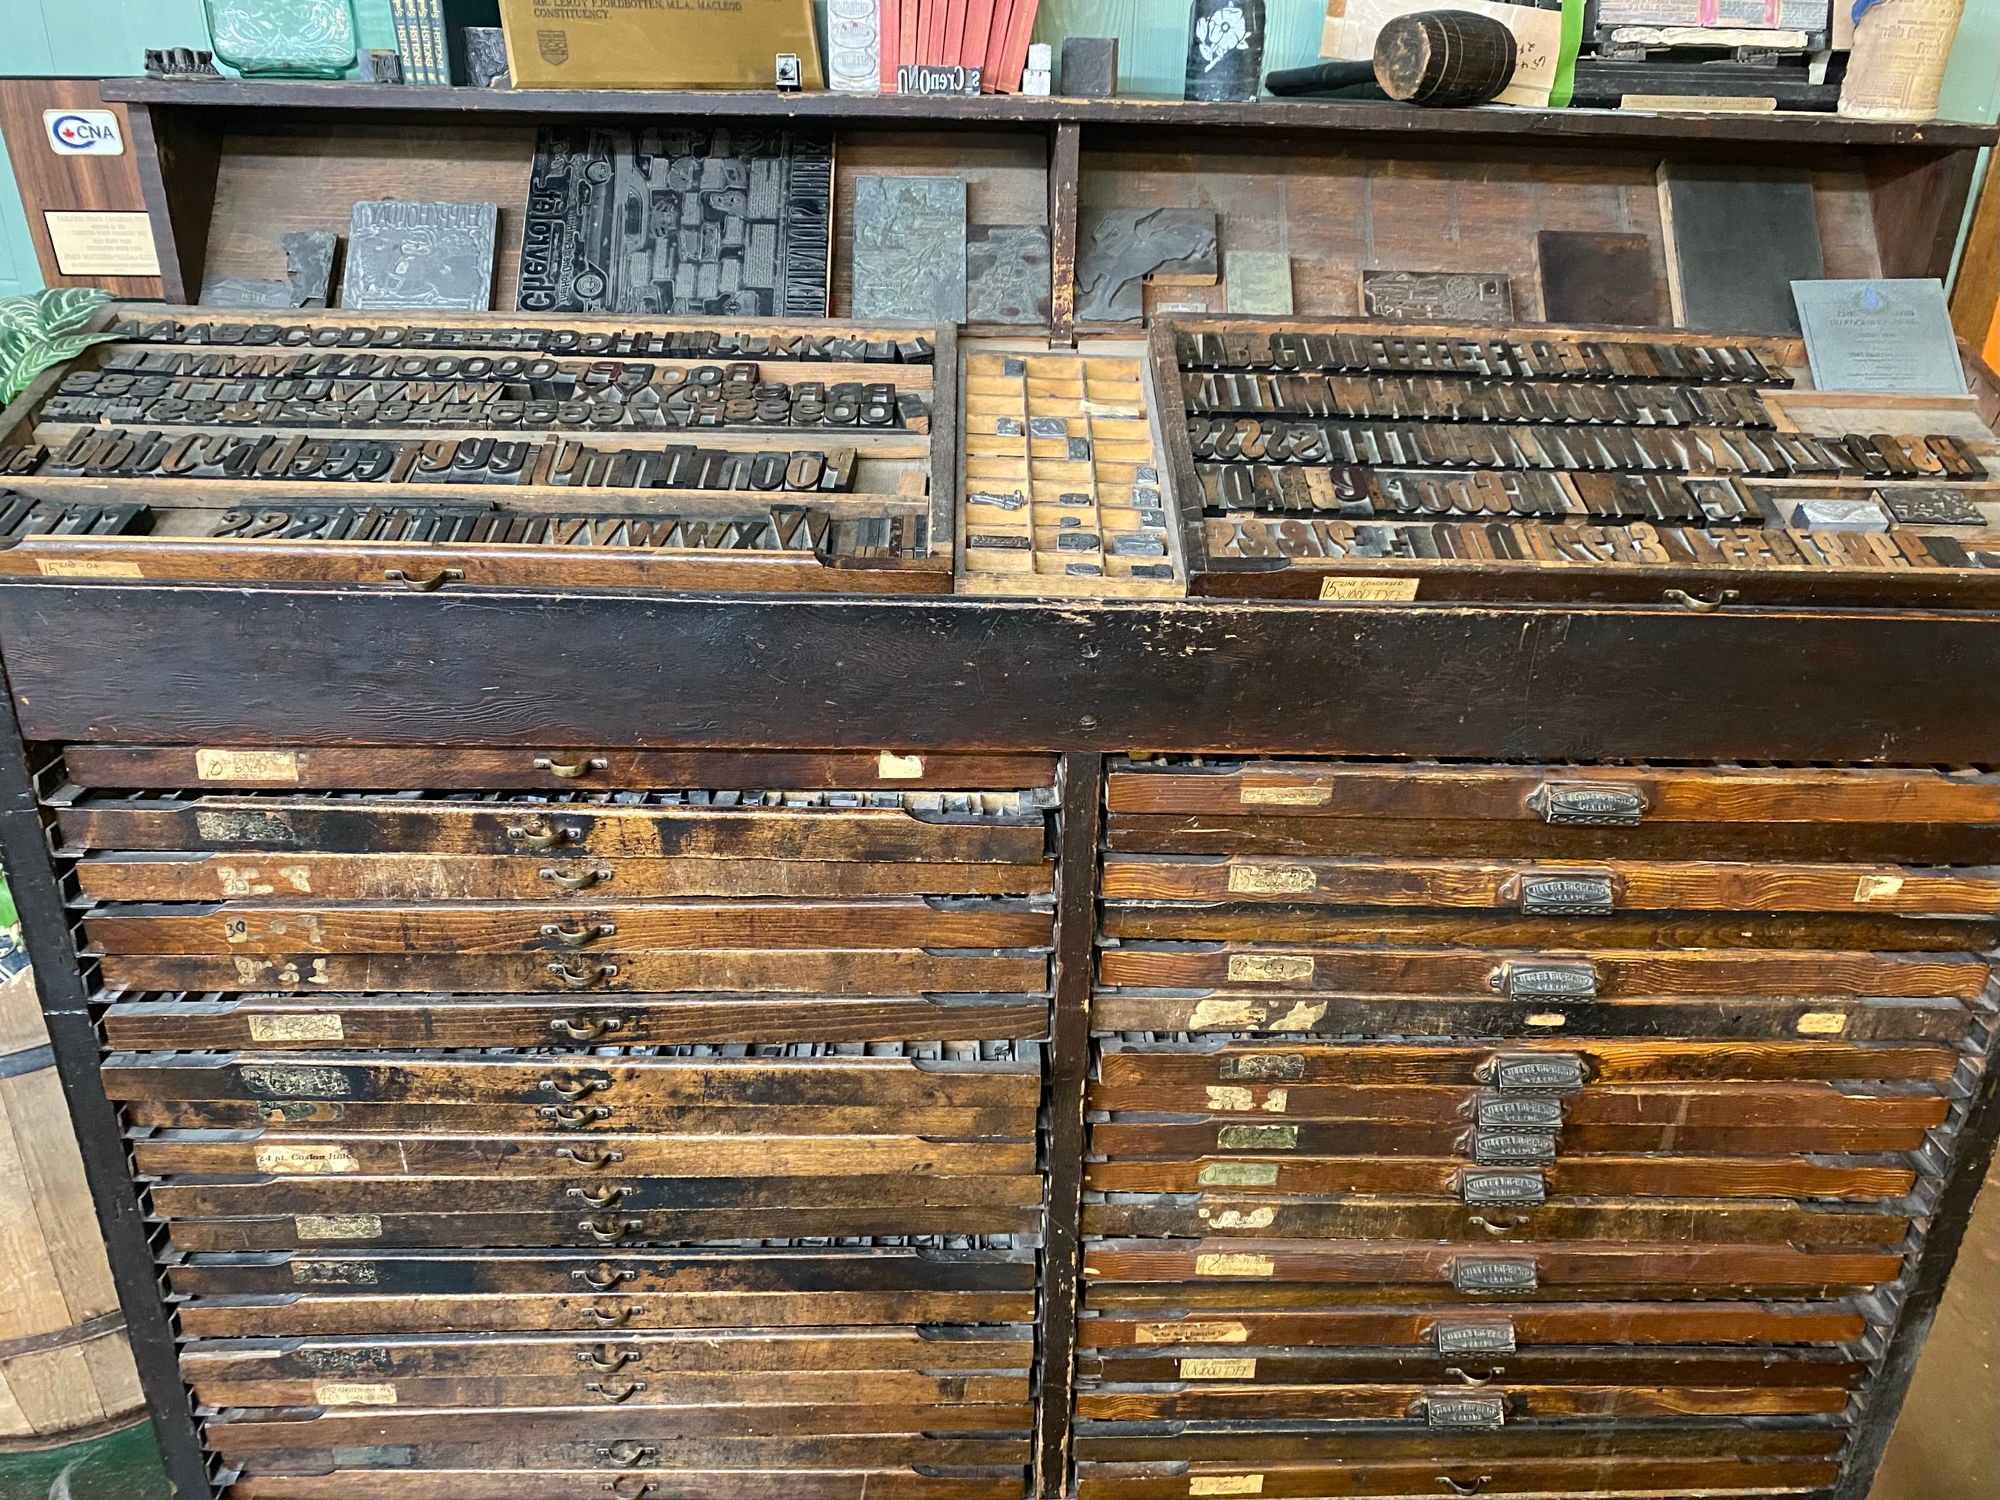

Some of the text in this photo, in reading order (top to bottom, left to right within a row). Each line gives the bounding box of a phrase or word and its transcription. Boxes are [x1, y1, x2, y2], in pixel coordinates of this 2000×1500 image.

[554, 0, 589, 9] LEROY
[697, 2, 742, 12] MACLEOD
[397, 25, 411, 67] ENGLISH
[409, 25, 423, 67] ENGLISH
[420, 25, 434, 67] ENGLISH
[433, 27, 444, 69] ENGLISH
[77, 125, 114, 140] CNA
[225, 920, 246, 938] 30
